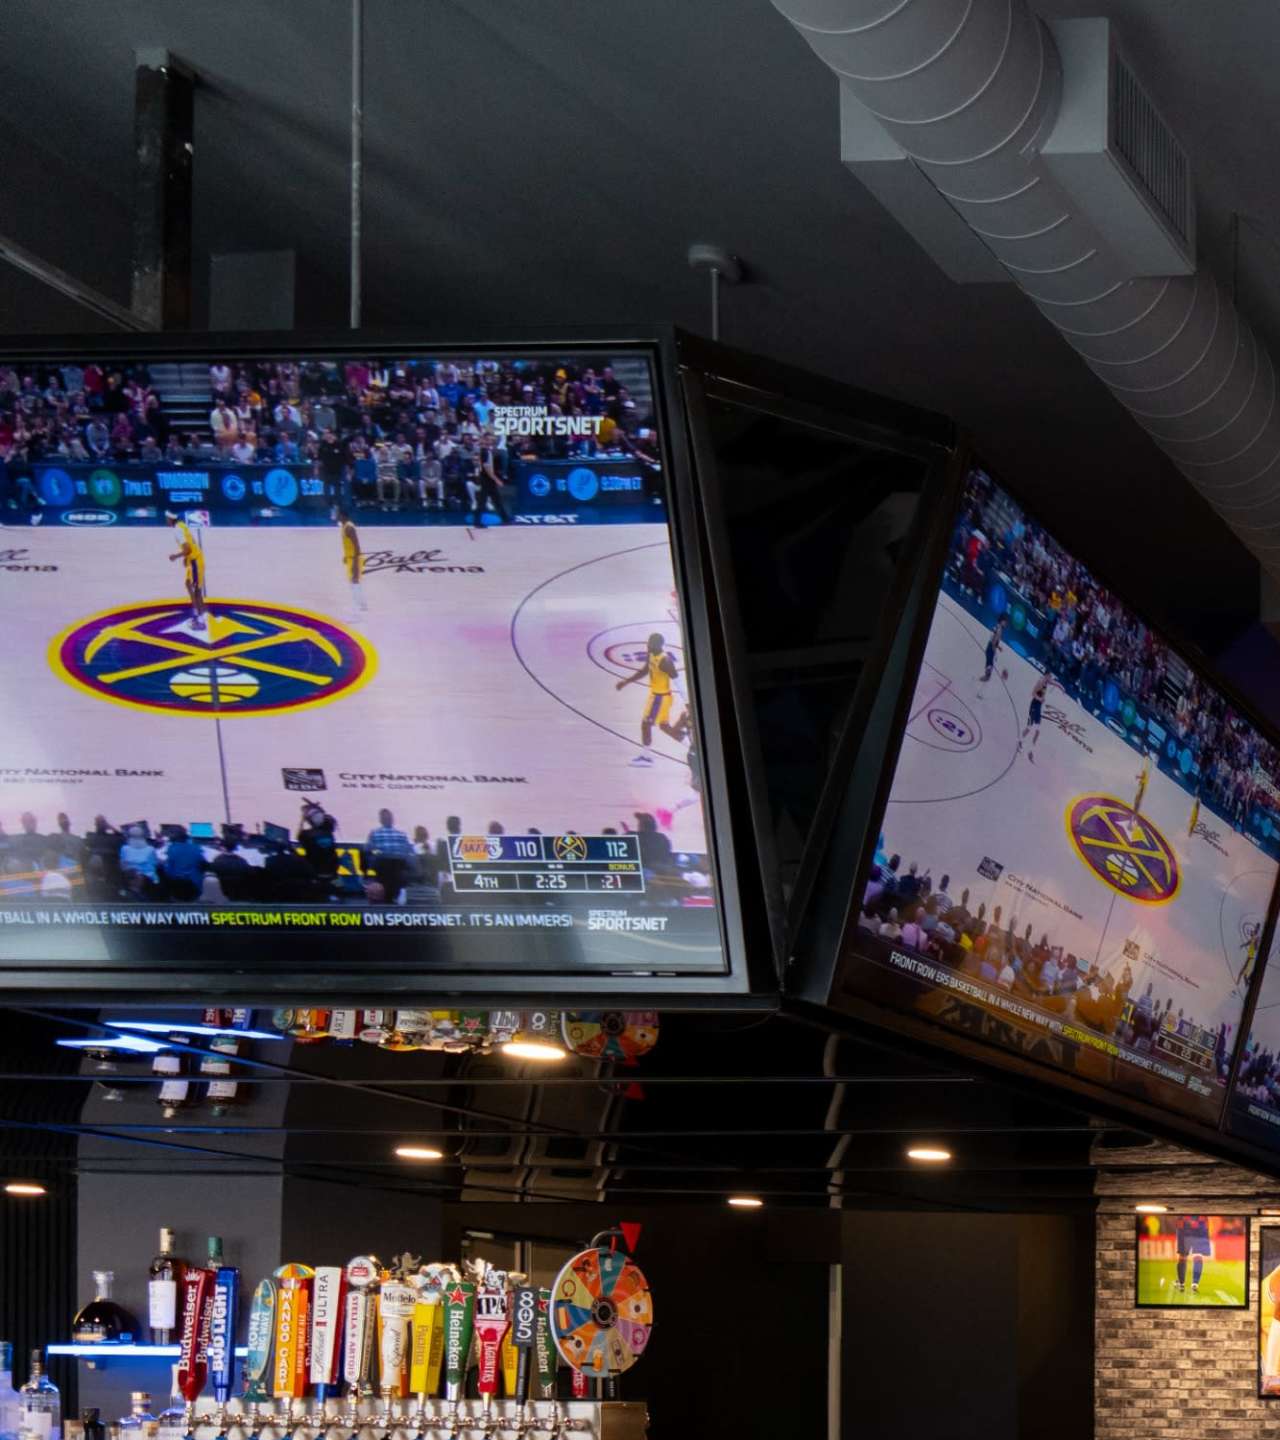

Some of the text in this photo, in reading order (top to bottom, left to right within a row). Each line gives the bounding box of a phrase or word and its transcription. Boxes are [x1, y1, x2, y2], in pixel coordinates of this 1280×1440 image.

[494, 406, 547, 417] SPECTRUM
[494, 416, 603, 435] SPORTSNET
[396, 563, 485, 574] Arena
[515, 841, 537, 857] 110
[606, 841, 628, 858] 112
[536, 875, 567, 889] 2:25
[601, 876, 622, 889] :21
[37, 912, 50, 925] IN
[53, 912, 61, 925] A
[63, 912, 109, 926] WHOLE
[111, 912, 142, 926] NEW
[143, 913, 177, 926] WAY
[178, 913, 210, 926] WITH
[212, 913, 282, 927] SPECTRUM
[284, 913, 328, 926] FRONT
[331, 913, 362, 926] ROW
[364, 914, 385, 926] ON
[387, 914, 467, 927] SPORTSNET.
[495, 914, 514, 926] AN
[588, 917, 668, 931] SPORTSNET
[889, 951, 916, 971] FRONT
[916, 962, 936, 980] ROW
[317, 1274, 328, 1319] ULTRA
[383, 1291, 416, 1305] Modelo
[351, 1296, 359, 1329] STELLA
[178, 1284, 198, 1371] Budweiser
[196, 1295, 214, 1364] Budweiser
[212, 1284, 228, 1371] BUD LIGHT
[278, 1291, 292, 1390] MANGO CART
[450, 1309, 464, 1370] Heineken
[536, 1316, 549, 1374] Heineken
